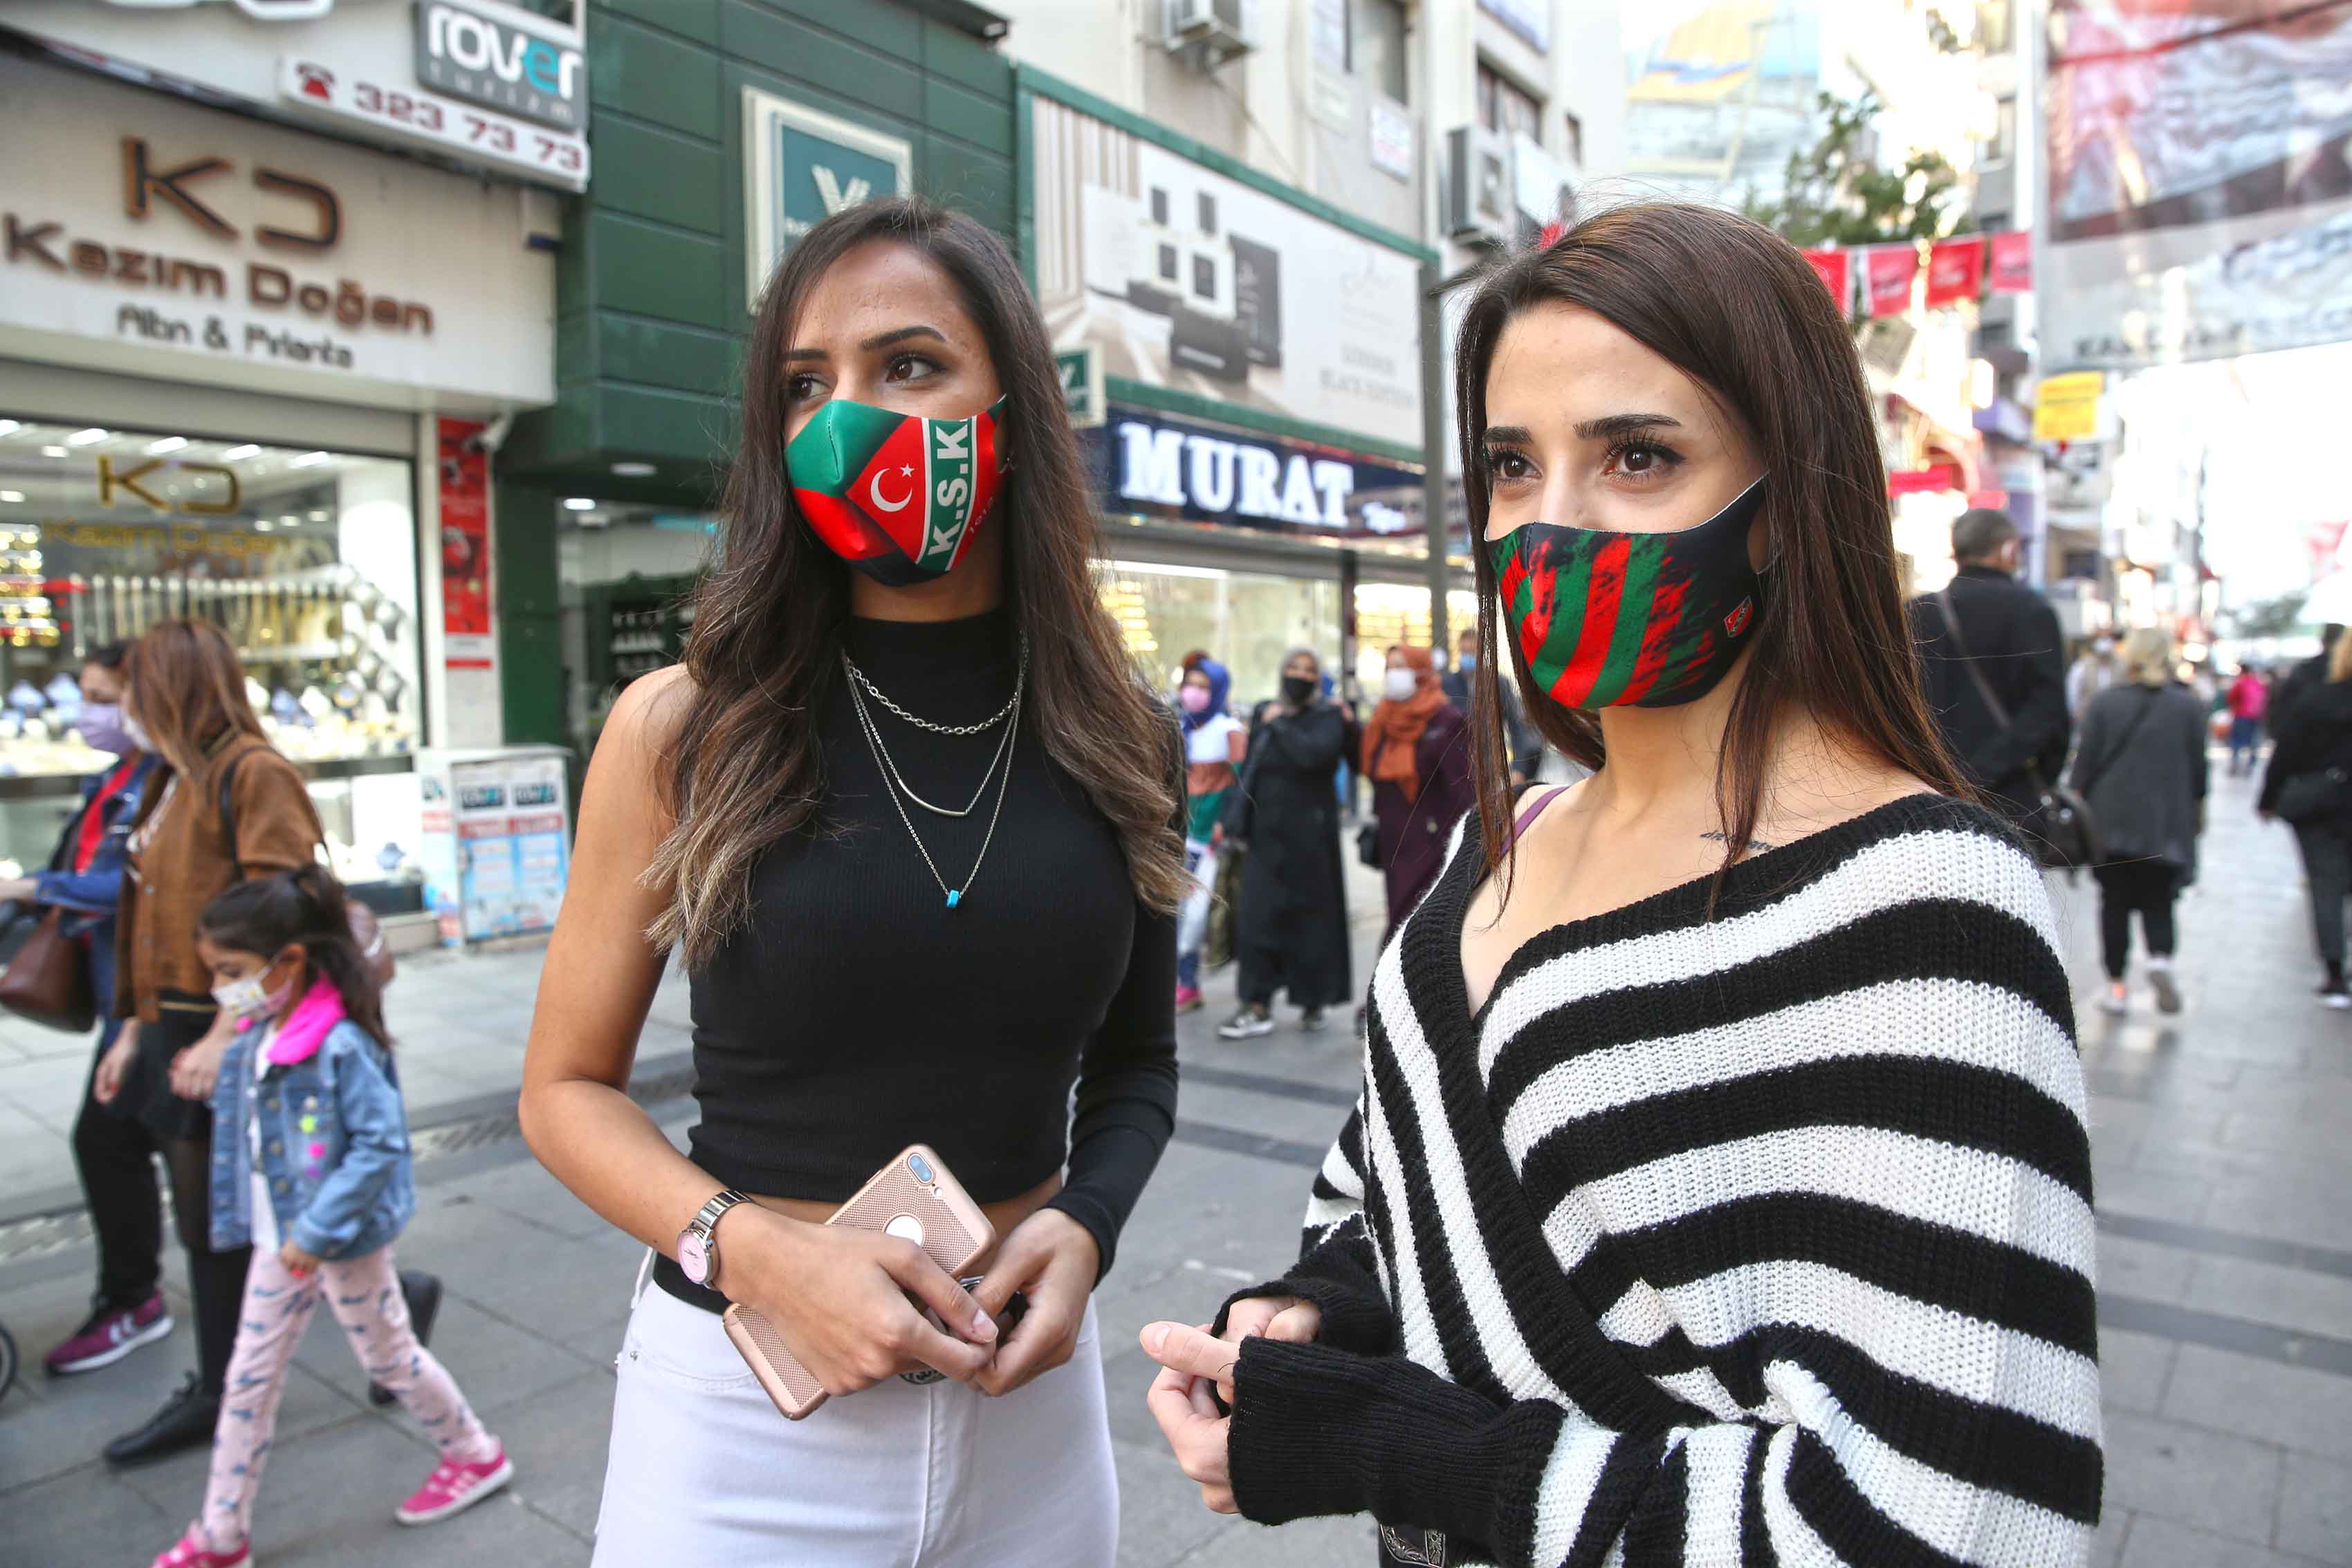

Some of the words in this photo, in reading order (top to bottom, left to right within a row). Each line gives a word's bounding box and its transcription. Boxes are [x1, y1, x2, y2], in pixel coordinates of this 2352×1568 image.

[428, 5, 583, 100] rover
[353, 80, 444, 131] 323
[463, 112, 516, 153] 73
[533, 136, 582, 171] 73
[121, 136, 344, 249] KD
[245, 261, 434, 336] Doğan
[1118, 421, 1354, 528] MURAT
